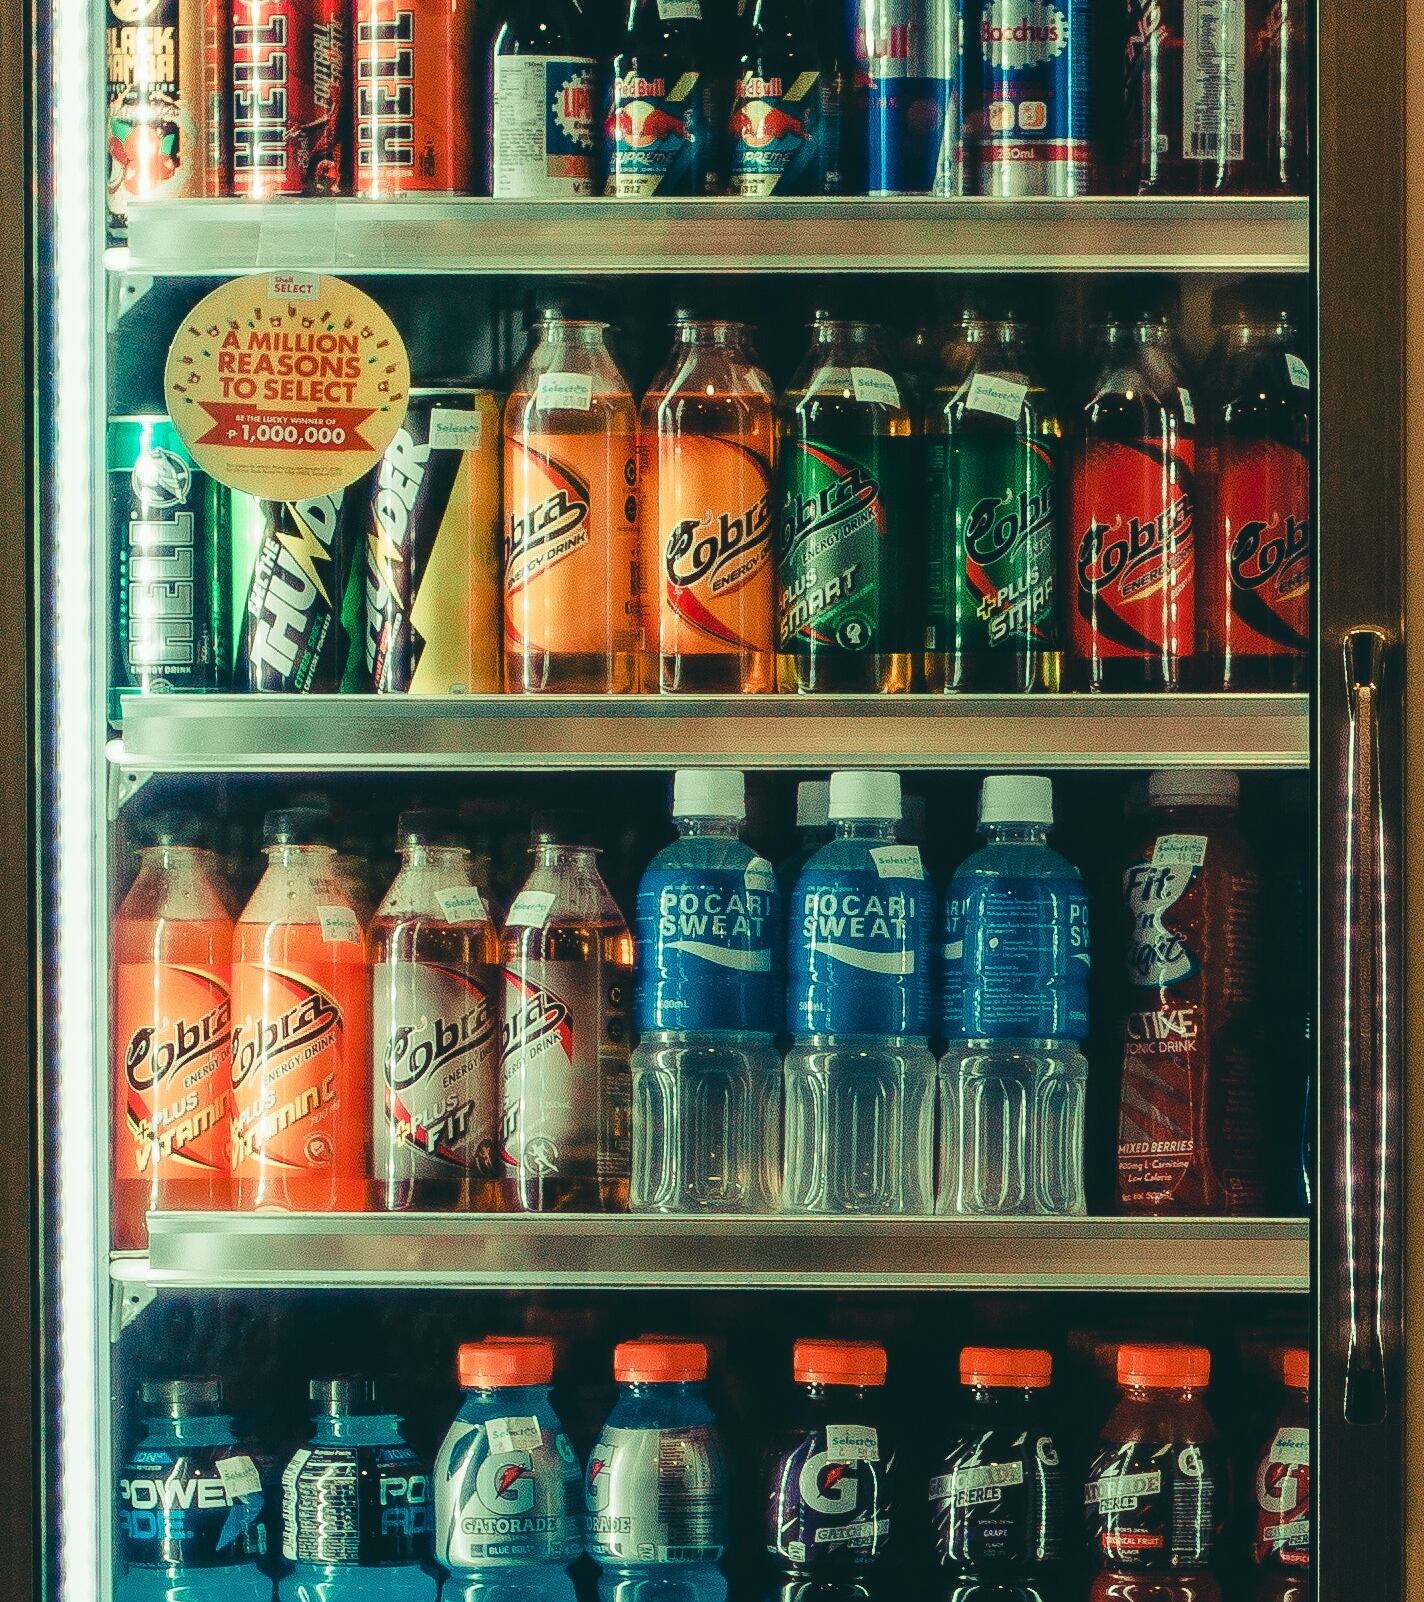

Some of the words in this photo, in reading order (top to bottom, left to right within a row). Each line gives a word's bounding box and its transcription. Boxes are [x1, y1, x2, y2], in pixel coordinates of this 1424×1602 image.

[981, 17, 1058, 43] Bacchus
[233, 14, 288, 170] HELL
[357, 10, 415, 167] HELL
[274, 284, 314, 293] SELECT
[221, 330, 241, 350] A
[247, 331, 359, 354] MILLION
[217, 351, 361, 379] REASONS
[219, 376, 257, 400] TO
[262, 378, 358, 403] SELECT
[241, 425, 347, 445] 1,000,000
[546, 531, 586, 560] DRINK
[801, 530, 842, 566] ENERGY
[843, 505, 876, 542] DRINK
[711, 554, 761, 592] ENERGY
[996, 566, 1040, 606] PLUS
[128, 511, 194, 665] HELL
[780, 563, 860, 647] SMART
[1126, 866, 1176, 899] Fit
[659, 893, 771, 917] POCARI
[803, 893, 915, 918] POCARI
[659, 917, 765, 938] SWEAT
[802, 917, 907, 939] SWEAT
[383, 997, 497, 1091] Cobra
[529, 1031, 562, 1059] DRINK
[1159, 1041, 1198, 1053] DRINK
[264, 1056, 301, 1087] ENERGY
[303, 1033, 336, 1061] DRINK
[442, 1054, 480, 1088] ENERGY
[184, 1063, 218, 1089] ENERGY
[153, 1092, 199, 1127] PLUS
[410, 1093, 459, 1128] PLUS
[426, 1100, 475, 1152] FIT
[1118, 1142, 1149, 1154] MIXED
[1150, 1140, 1194, 1153] BERRIES
[462, 1516, 556, 1535] GATORADE
[983, 1529, 1008, 1537] GRAPE
